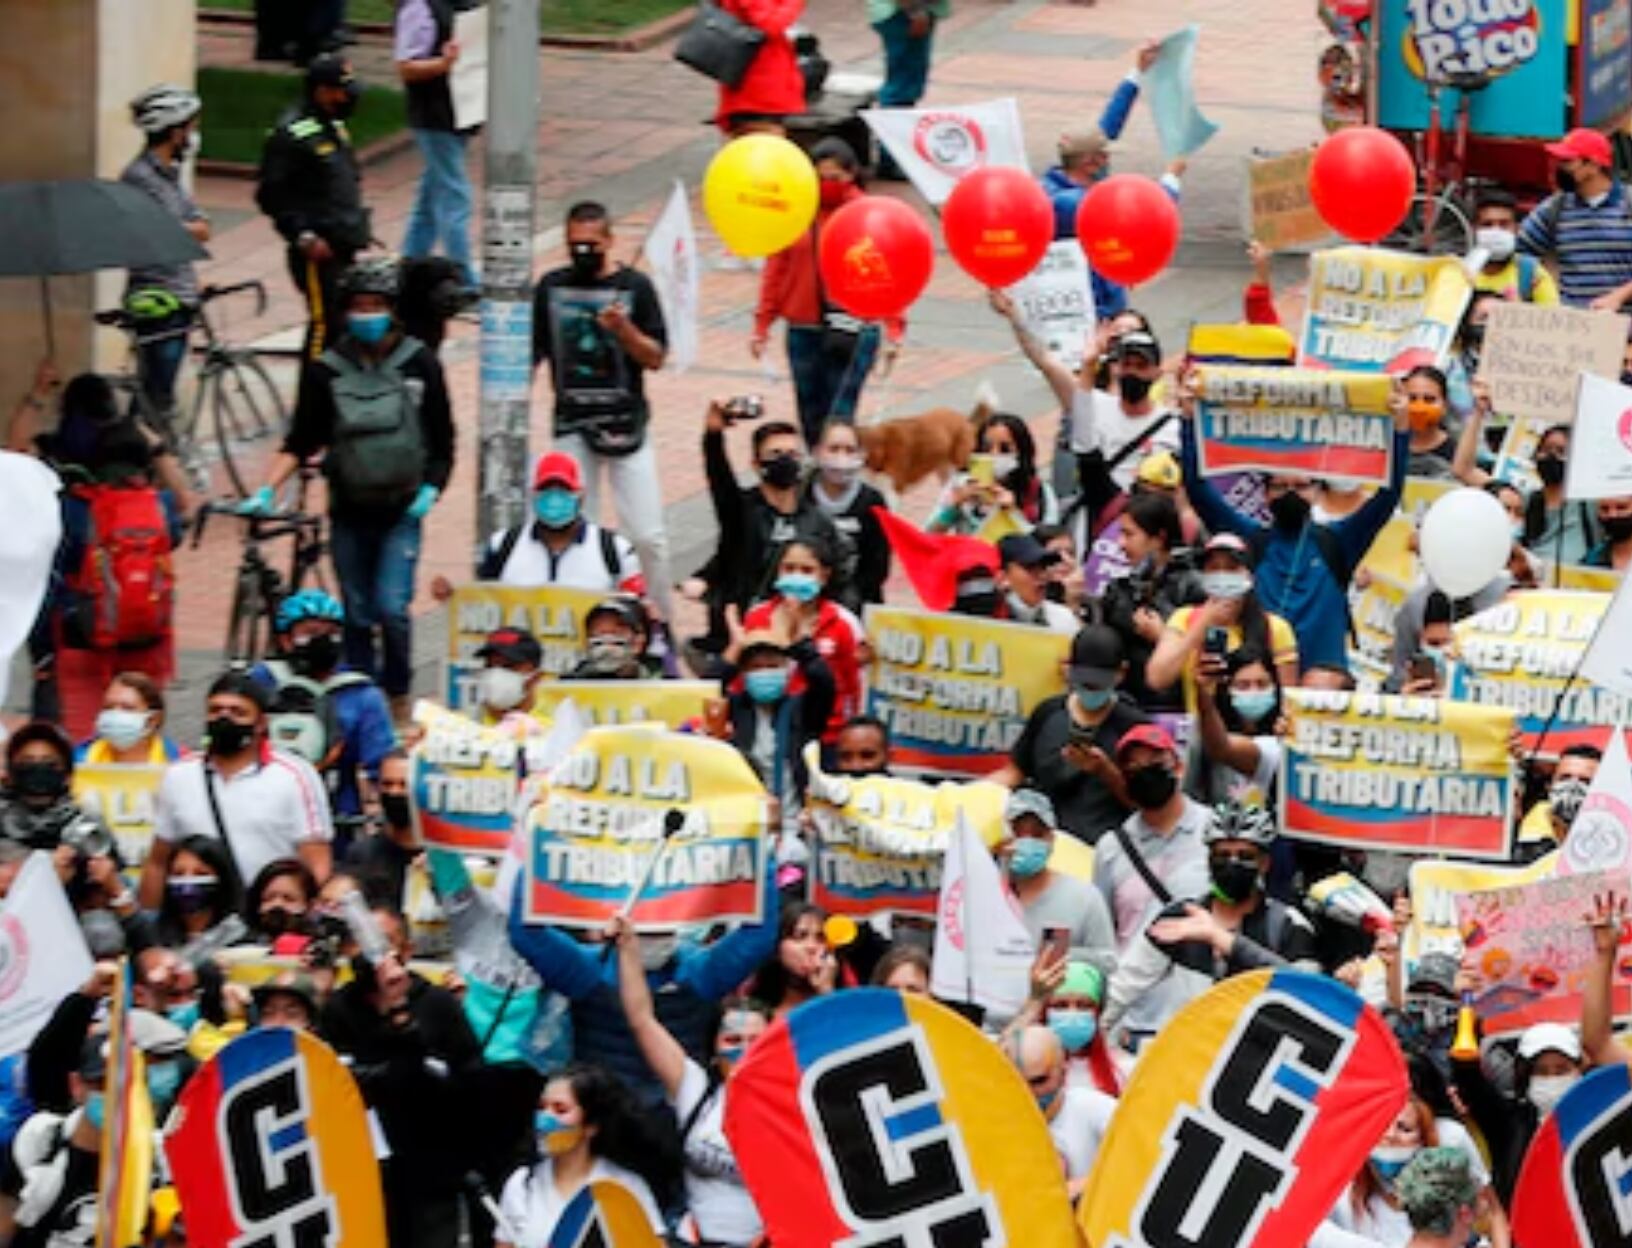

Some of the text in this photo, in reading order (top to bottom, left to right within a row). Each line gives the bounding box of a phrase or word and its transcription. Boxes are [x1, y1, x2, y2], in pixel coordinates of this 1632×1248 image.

[1418, 26, 1537, 77] Rico
[1323, 262, 1425, 296] NO A LA
[1209, 375, 1346, 405] REFORMA
[1211, 411, 1384, 447] TRIBUTARIA
[458, 602, 574, 638] NO A LA
[1472, 602, 1519, 637] NO
[1527, 604, 1549, 635] A
[878, 630, 1001, 675] NO A LA
[875, 669, 1020, 714] REFORMA
[872, 700, 1024, 751] TRIBUTAR
[1299, 719, 1459, 769] REFORMA
[606, 757, 634, 793] A
[645, 758, 690, 799] LA
[1296, 763, 1501, 816] TRIBUTARIA
